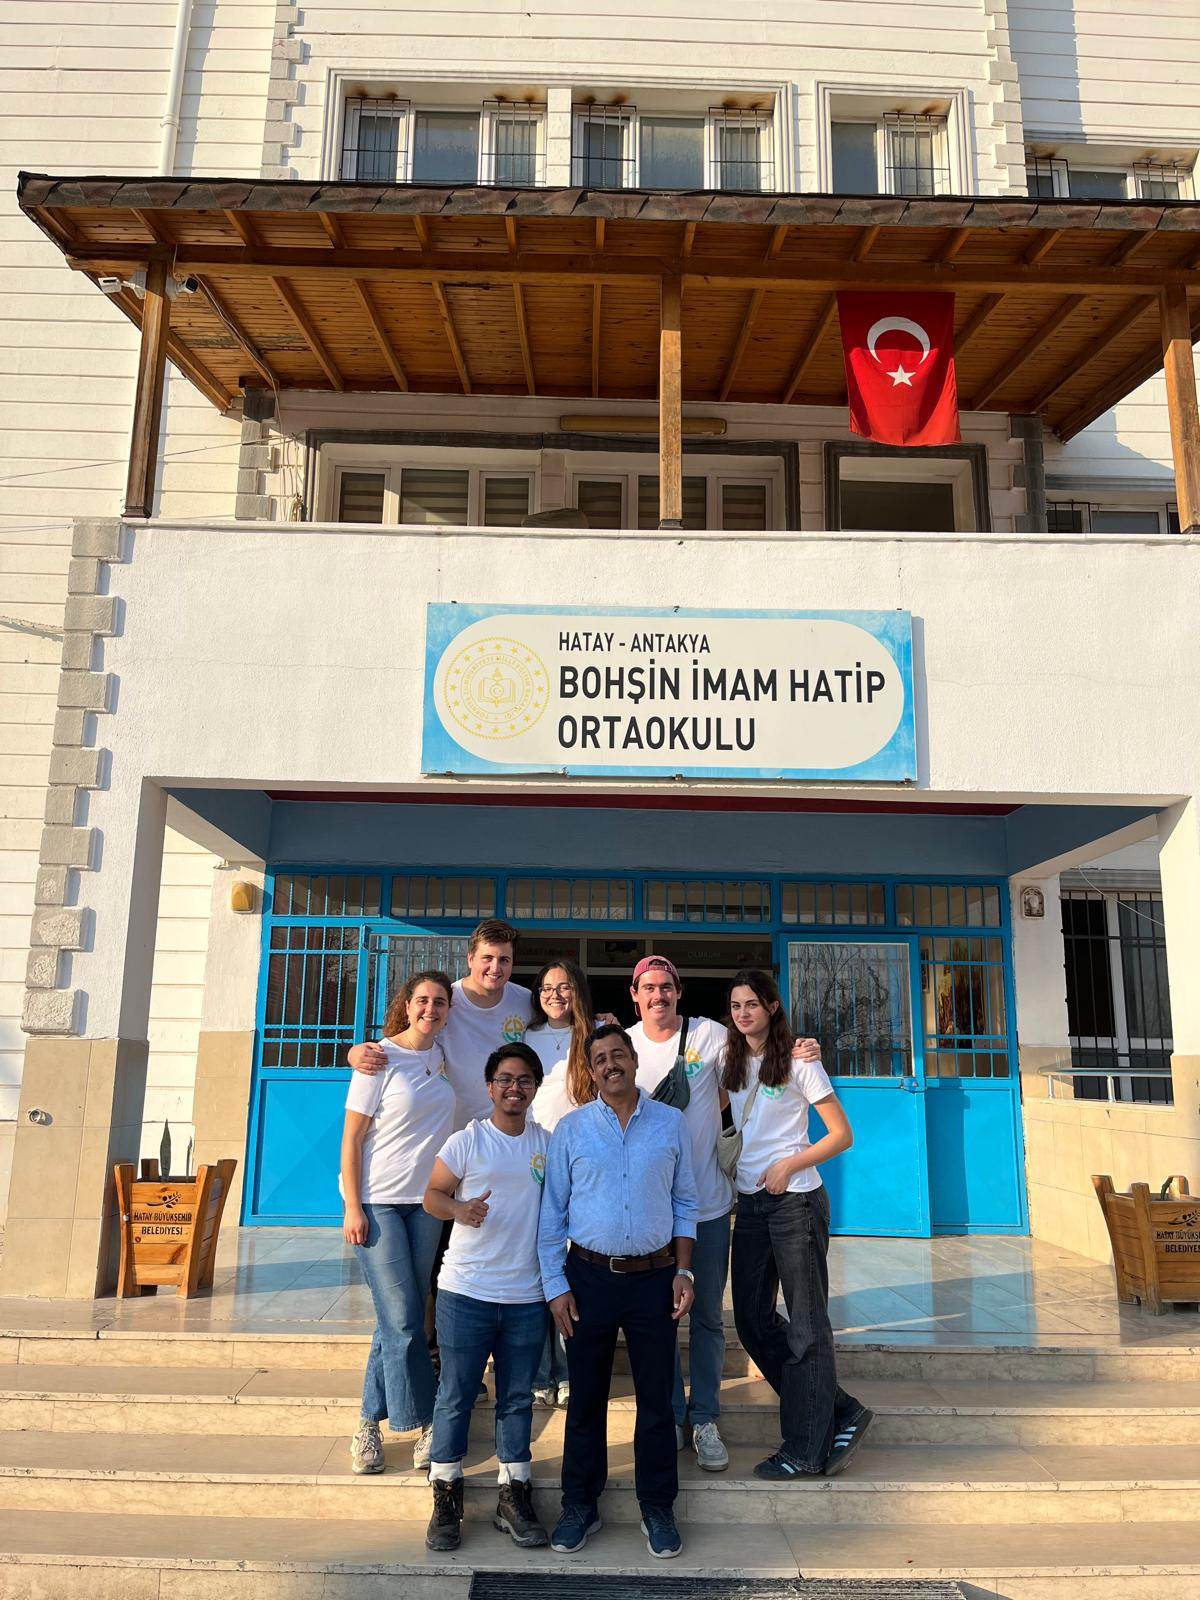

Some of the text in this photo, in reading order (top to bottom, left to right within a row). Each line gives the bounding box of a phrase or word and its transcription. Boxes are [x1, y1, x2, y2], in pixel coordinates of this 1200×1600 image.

[559, 631, 615, 652] HATAY
[630, 633, 711, 654] ANTAKYA
[559, 658, 680, 705] BOHŞİN
[692, 659, 778, 702] İMAM
[789, 661, 886, 704] HATİP
[558, 714, 755, 751] ORTAOKULU
[134, 1212, 153, 1221] HATAY
[1156, 1231, 1175, 1240] HATAY
